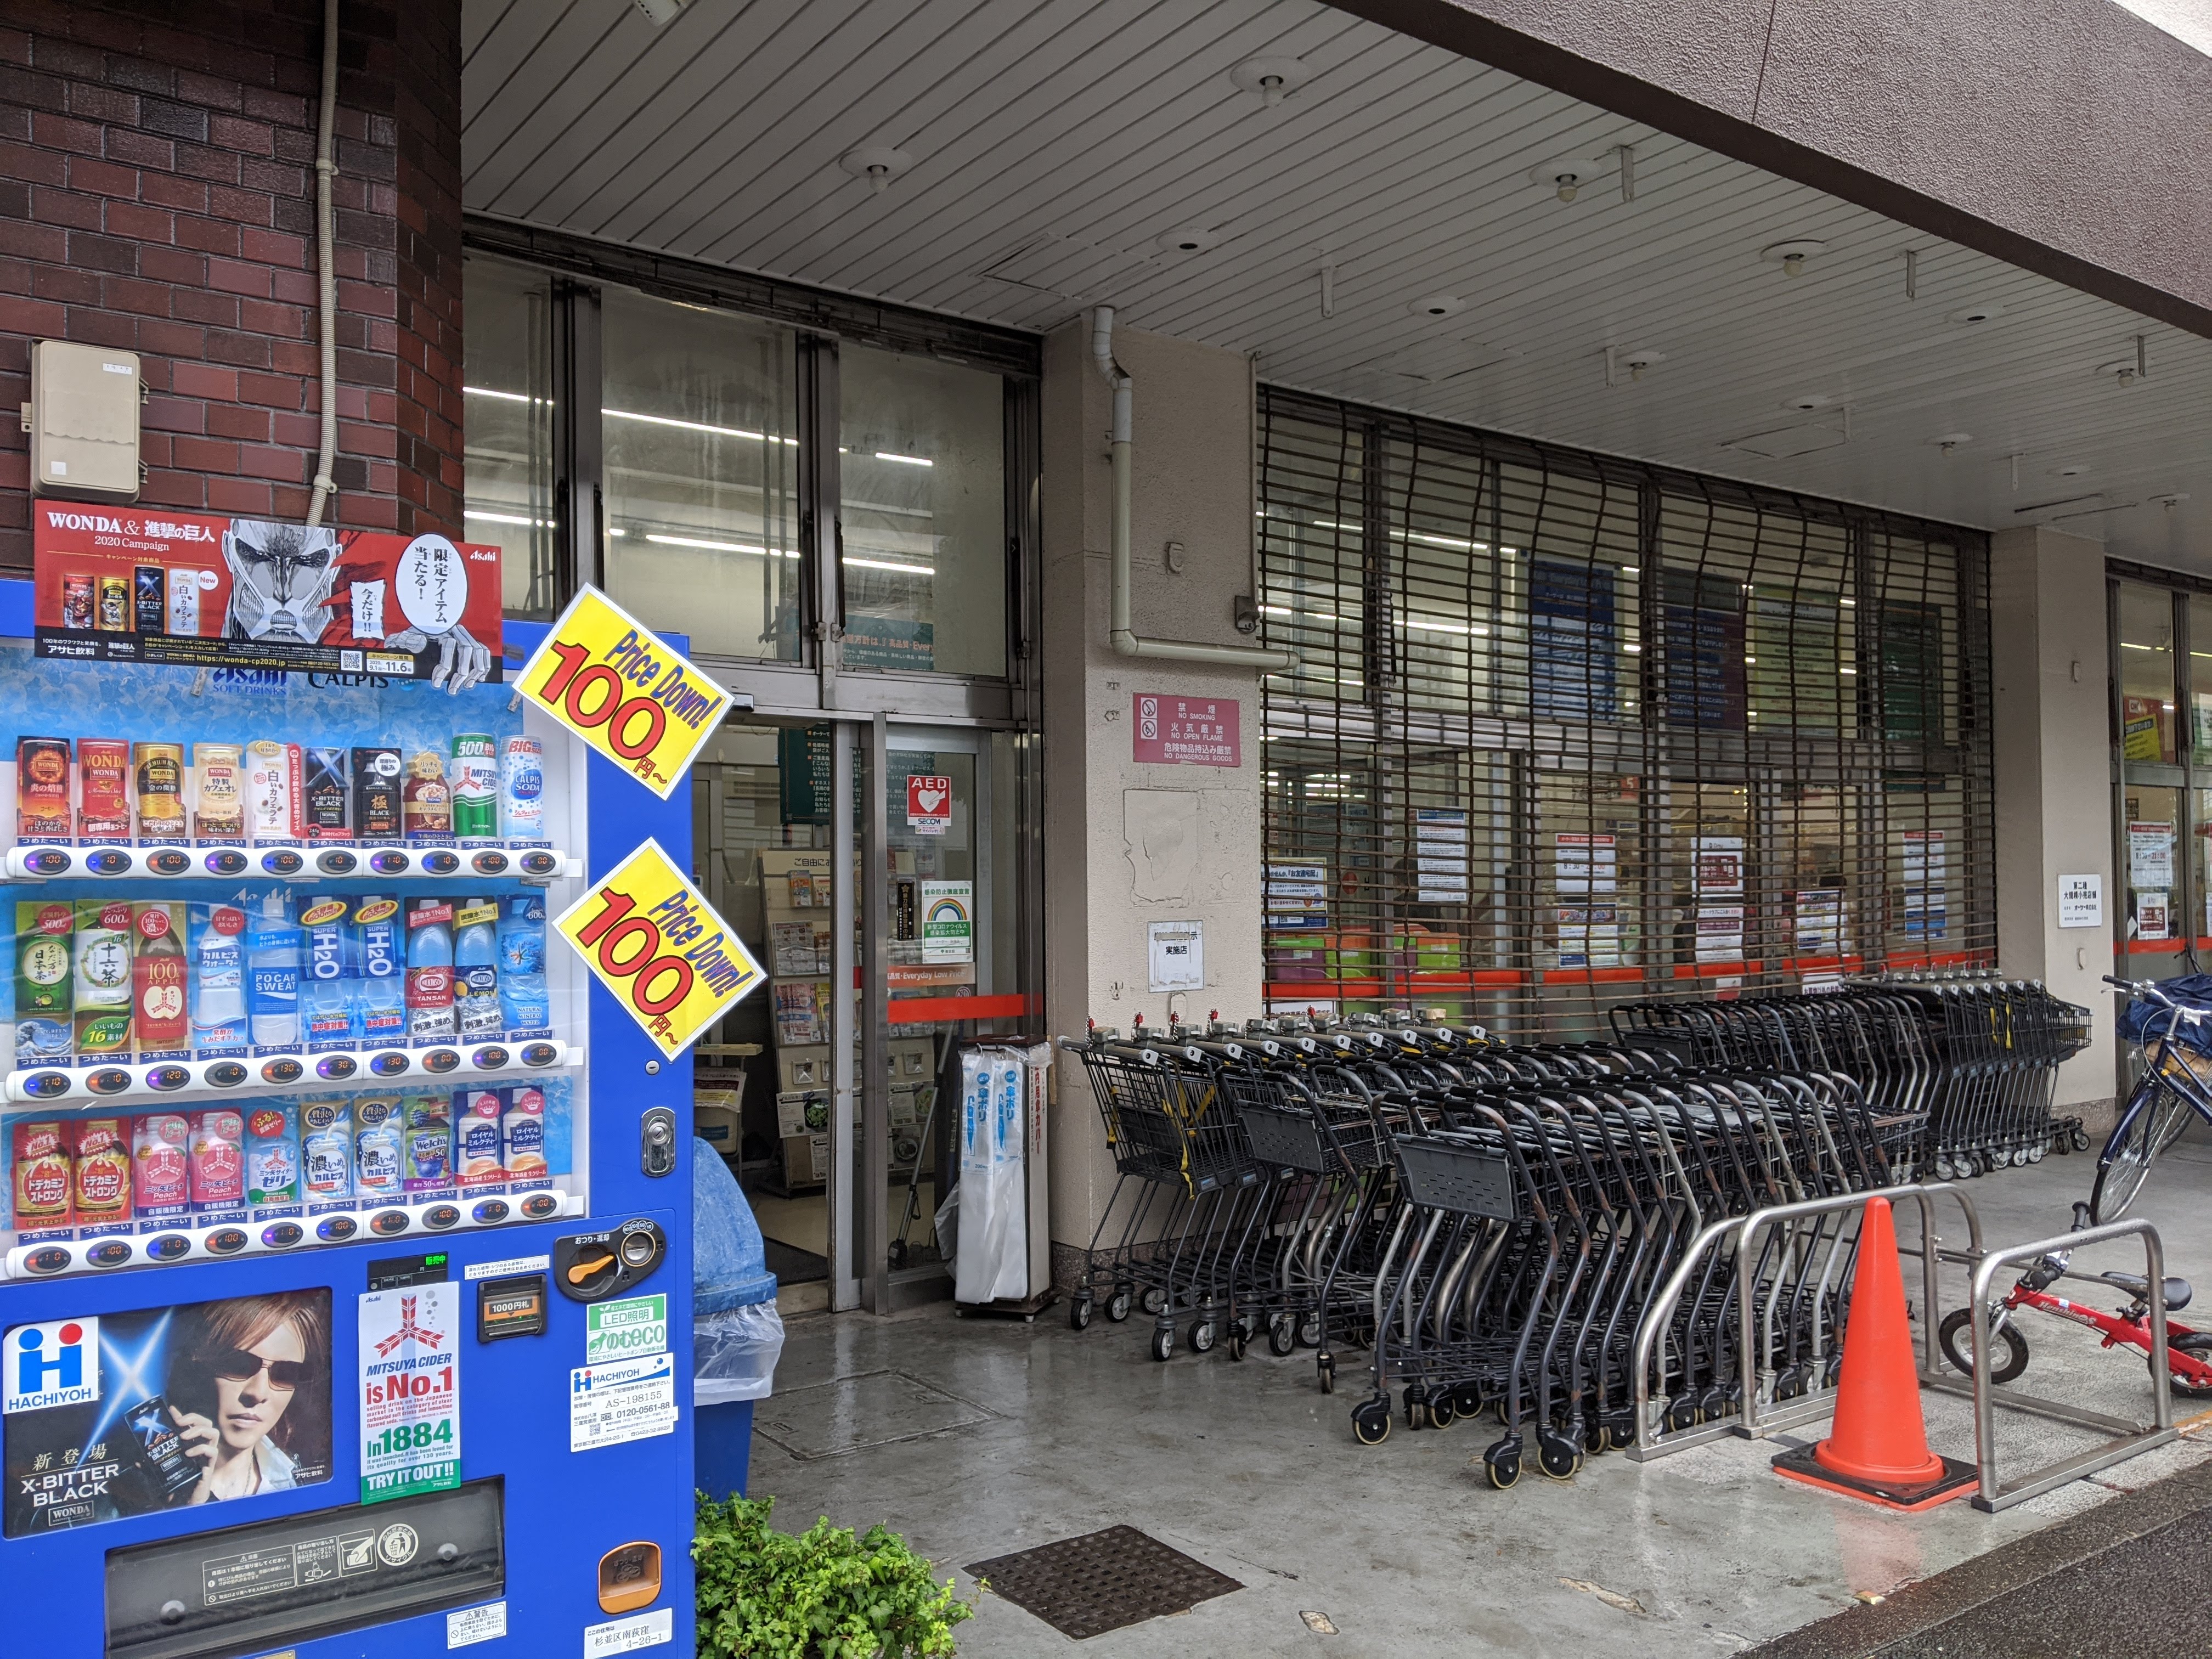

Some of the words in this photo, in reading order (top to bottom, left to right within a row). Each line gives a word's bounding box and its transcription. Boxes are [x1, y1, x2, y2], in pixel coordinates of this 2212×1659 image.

[47, 512, 122, 533] WONDA
[124, 521, 140, 535] &
[145, 520, 215, 542] 進撃の巨人
[94, 536, 120, 546] 2020
[122, 538, 169, 551] Campaign
[106, 554, 160, 563] キャンペーン対象商品
[470, 550, 495, 561] Asahi
[434, 549, 448, 623] 限定アイテム
[179, 585, 188, 628] 白いカフェラテ
[48, 645, 94, 656] アサヒ飲料
[196, 654, 285, 667] https://wonda-cp2020.jp
[604, 628, 658, 687] Price
[663, 666, 724, 730] Down!
[213, 684, 241, 693] SOFT
[245, 686, 286, 695] DRINKS
[509, 741, 532, 753] BIG
[1164, 742, 1232, 755] 危険物品持込み厳禁
[515, 775, 540, 785] CALPIS
[911, 777, 947, 789] AED
[31, 784, 63, 793] 炎の焙煎
[149, 784, 176, 792] 金の微糖
[204, 785, 236, 793] カフェオレ
[515, 783, 540, 792] SODA
[268, 770, 279, 825] 白いカフェラテ
[104, 905, 128, 915] たっぷり
[647, 890, 699, 947] Price
[684, 931, 756, 998] Down!
[1165, 945, 1187, 955] 実施店
[202, 952, 238, 960] カルピス
[314, 933, 339, 979] H2O
[368, 932, 392, 976] H2O
[34, 950, 47, 980] 日本茶
[100, 943, 120, 988] 十六茶
[413, 1017, 454, 1030] 刺激、強め。
[202, 1035, 244, 1043] 生みだすチカラ
[1006, 1085, 1015, 1120] 傘ポリ
[31, 1138, 50, 1150] No.1
[416, 1135, 446, 1150] Welch's
[311, 1156, 343, 1171] 濃いめ
[262, 1176, 291, 1187] ゼリー
[314, 1173, 343, 1181] カルピス
[29, 1178, 64, 1190] ドデカミン
[144, 1183, 184, 1194] 三ツ矢ピーチ
[31, 1189, 63, 1202] ストロング
[148, 1206, 183, 1215] 自販機限定
[575, 1233, 610, 1245] おつり・返却
[426, 1255, 445, 1266] 販売中
[492, 1300, 529, 1313] 1000円札
[605, 1308, 649, 1325] LED照明
[606, 1324, 665, 1350] のむeco
[589, 1345, 665, 1362] 環境にやさしいヒートポンプ自動販売機
[366, 1358, 416, 1376] MITSUYA
[418, 1353, 452, 1367] CIDER
[593, 1368, 640, 1383] HACHIYOH
[366, 1382, 383, 1405] is
[387, 1366, 452, 1401] No.1
[9, 1388, 91, 1410] HACHIYOH
[426, 1393, 452, 1401] Japanese
[605, 1391, 662, 1408] AS-198155
[617, 1402, 670, 1419] 0120-0561-88
[366, 1414, 391, 1423] carbonated
[367, 1440, 381, 1458] In
[379, 1419, 453, 1454] 1884
[32, 1443, 108, 1472] 新登場
[376, 1460, 396, 1469] quality
[20, 1464, 119, 1494] X-BITTER
[367, 1471, 396, 1491] TRY
[397, 1469, 411, 1485] IT
[33, 1481, 109, 1507] BLACK
[386, 1550, 413, 1564] リサイクル
[587, 1625, 615, 1637] ここの住所は
[594, 1625, 650, 1647] 杉並区南荻窪
[627, 1633, 663, 1649] 4-26-1
